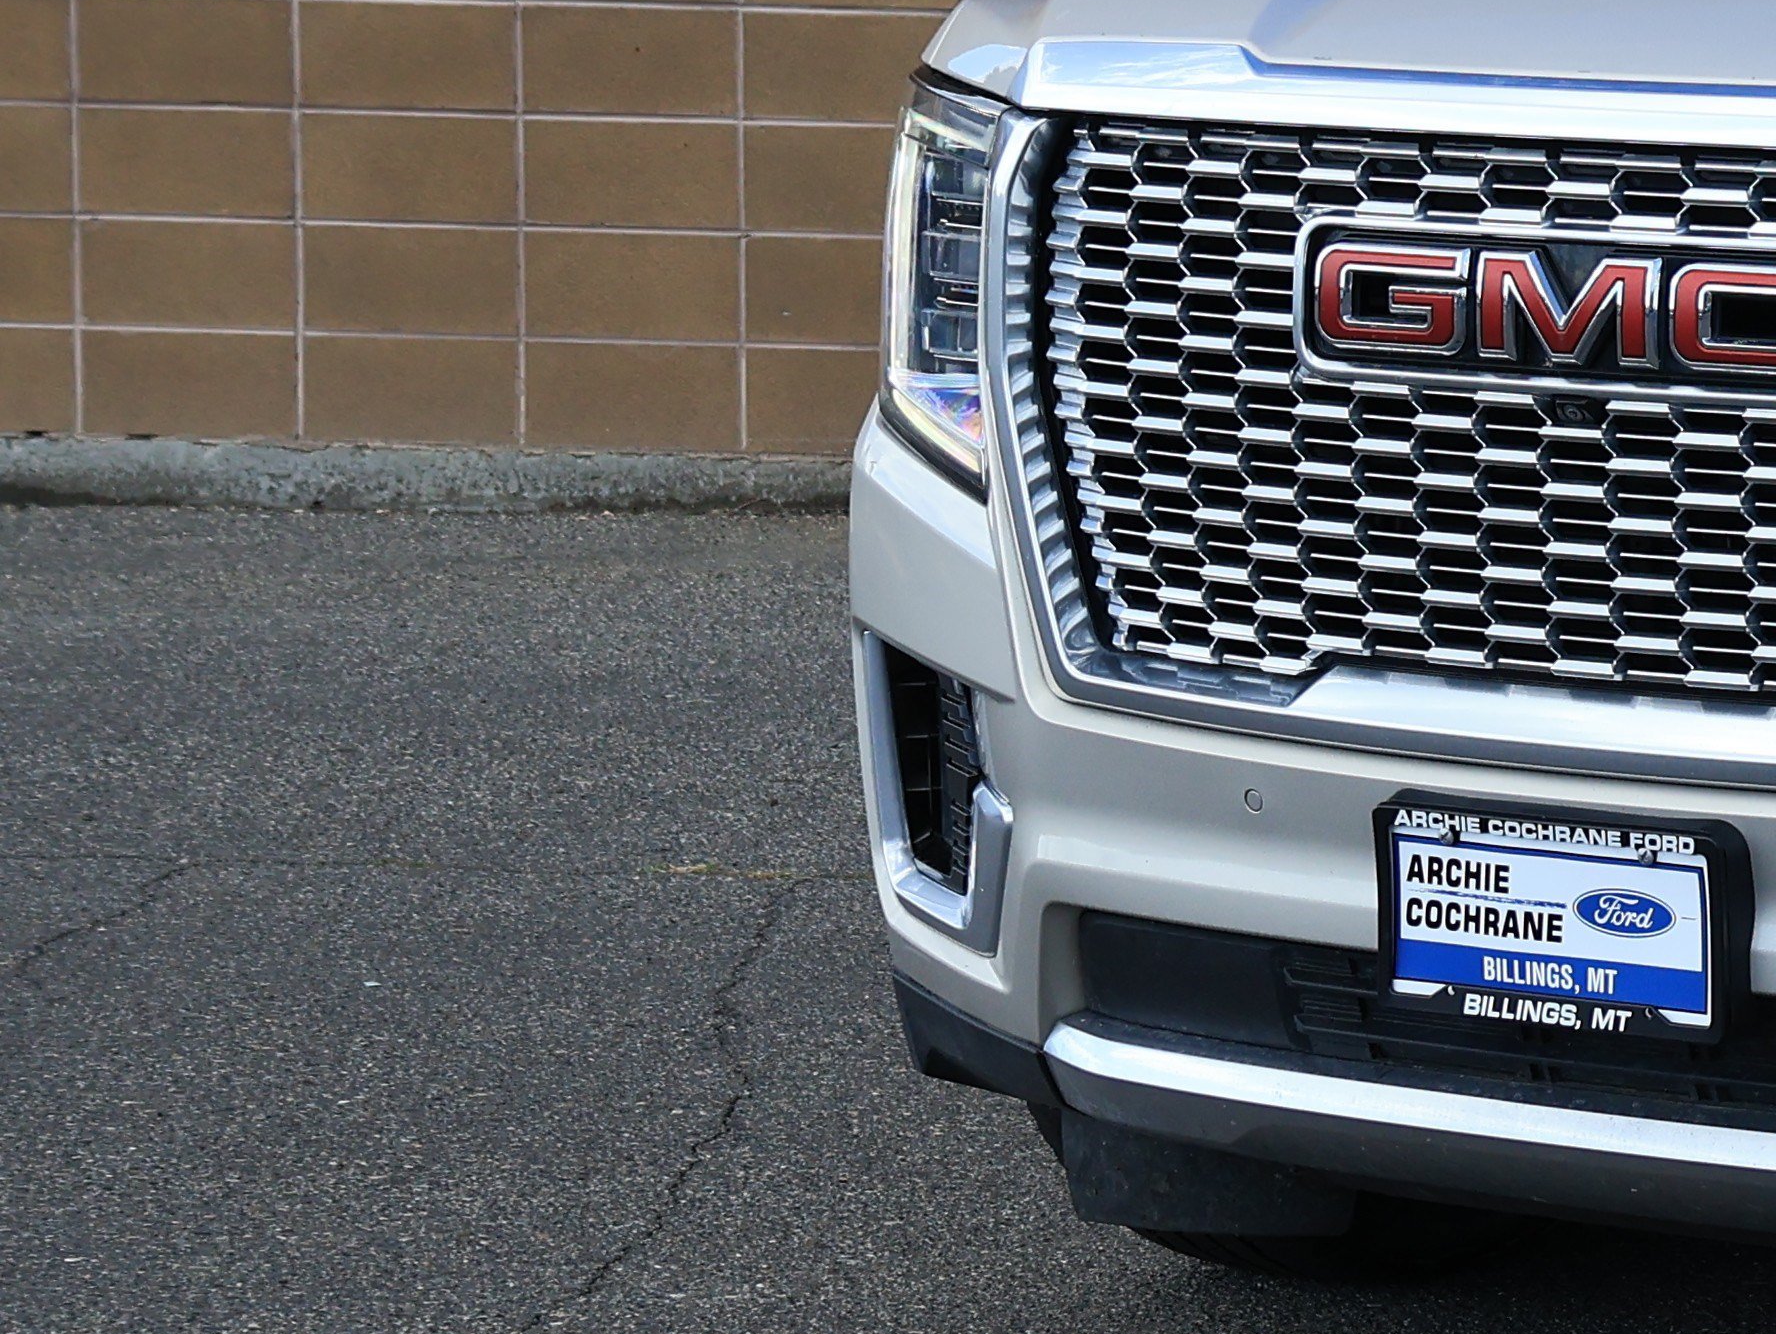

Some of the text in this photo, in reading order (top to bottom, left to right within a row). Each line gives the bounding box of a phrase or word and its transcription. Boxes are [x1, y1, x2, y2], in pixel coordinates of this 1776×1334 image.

[1394, 809, 1695, 855] ARCHIE COCHRANE FORD
[1406, 854, 1510, 894] ARCHIE
[1406, 897, 1564, 943] COCHRANE
[1594, 895, 1654, 929] Ford
[1483, 956, 1618, 995] BILLINGS, MT
[1463, 993, 1632, 1032] BILLINGS, MT
